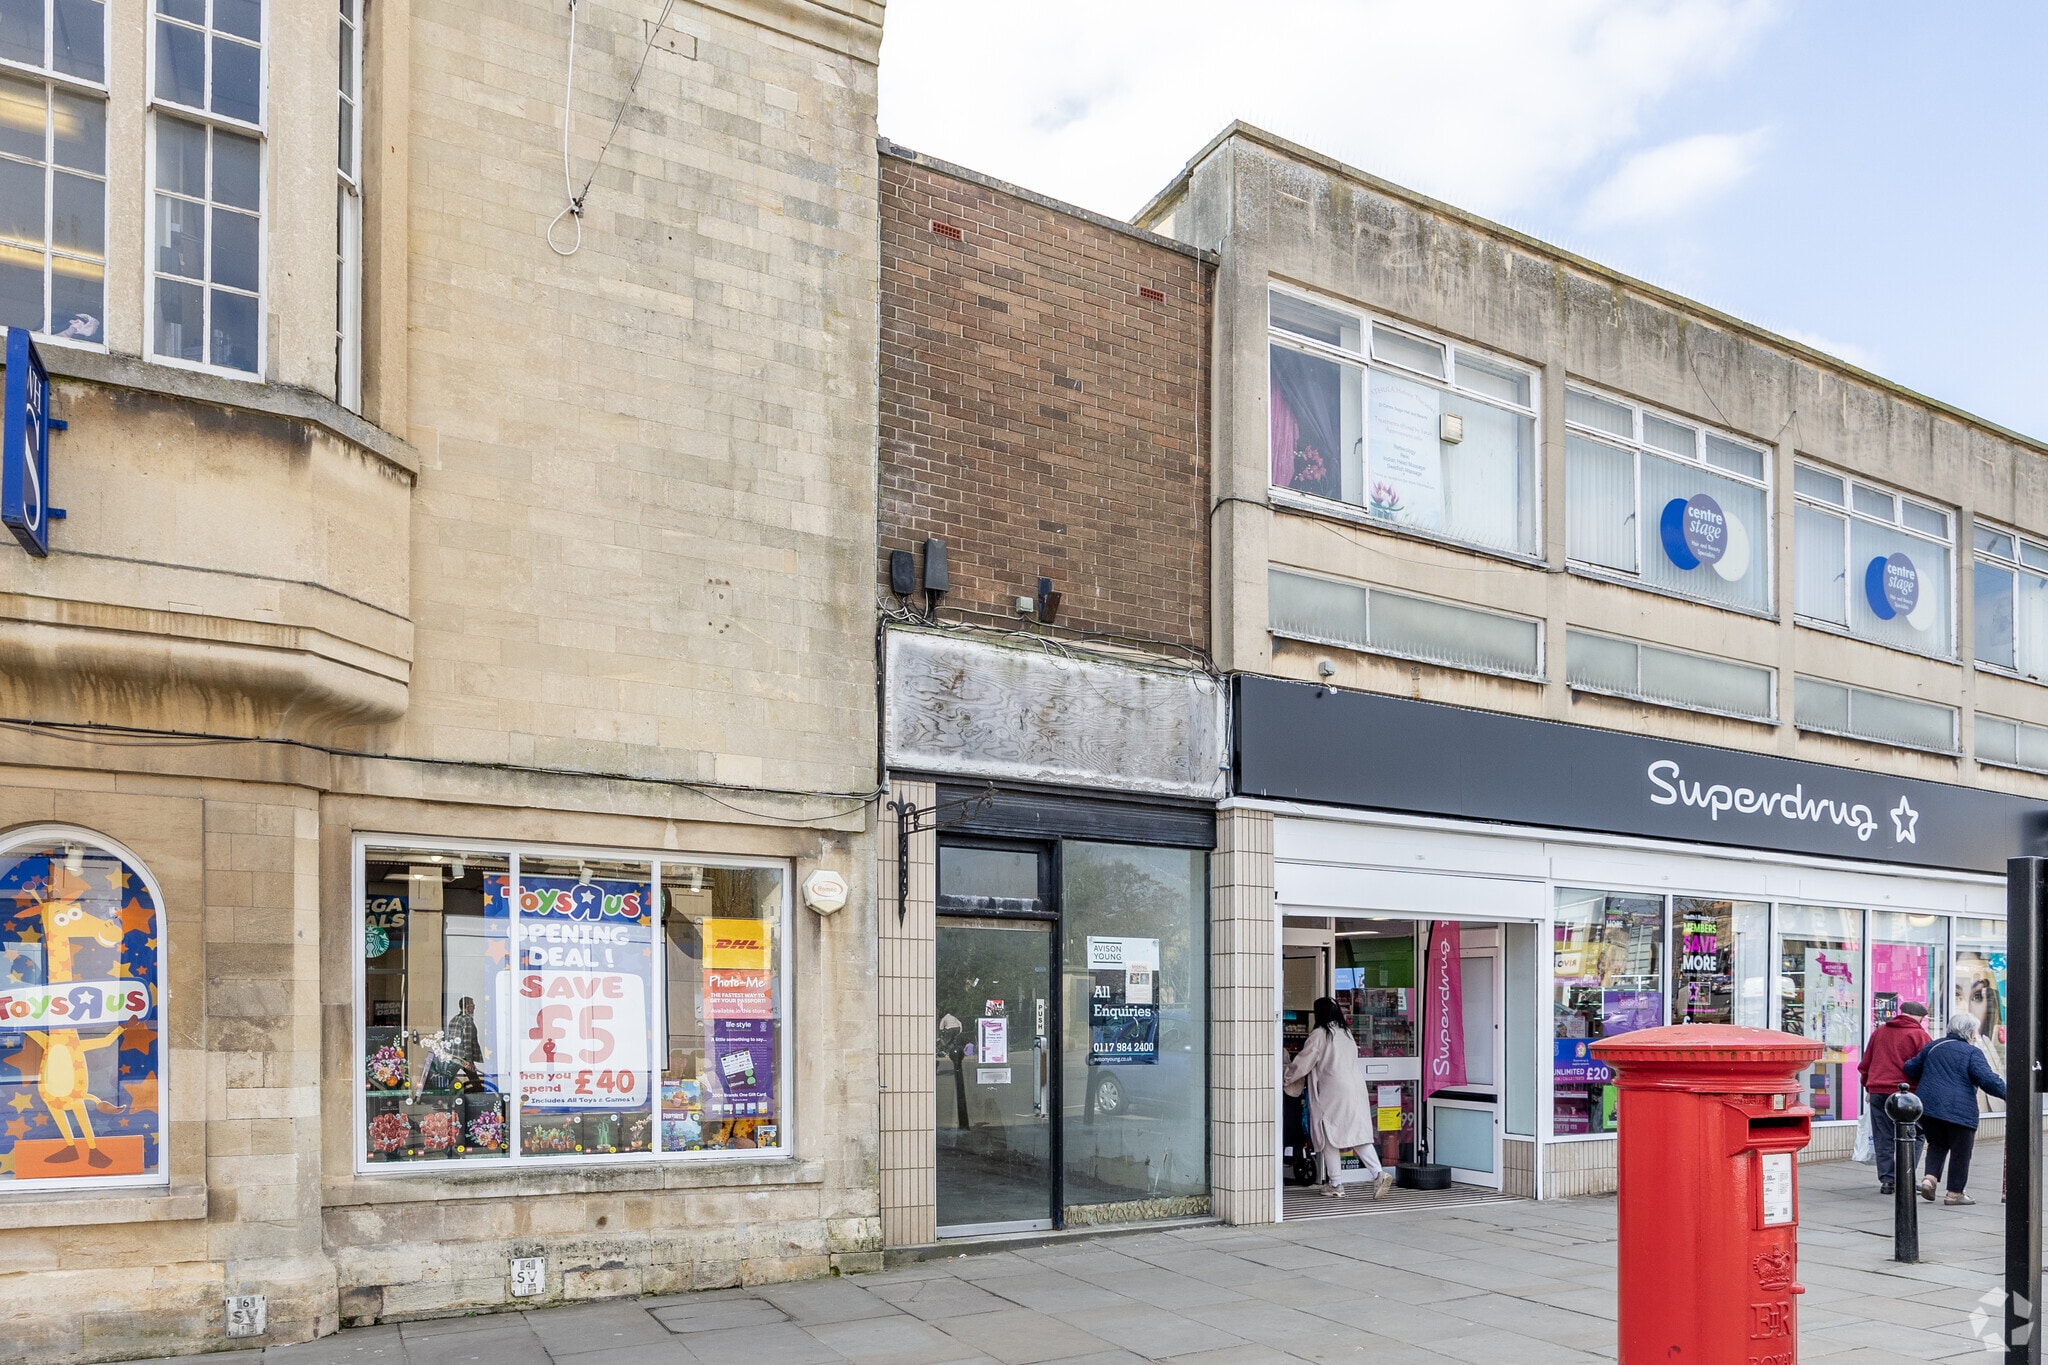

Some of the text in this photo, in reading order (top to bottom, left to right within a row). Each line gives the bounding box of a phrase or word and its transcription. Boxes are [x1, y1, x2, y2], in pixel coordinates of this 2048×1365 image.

[1688, 506, 1723, 525] centre
[1689, 520, 1722, 542] stage
[1887, 564, 1916, 580] centre
[1888, 576, 1914, 595] stage
[1648, 760, 1878, 841] Superdrug
[1683, 923, 1717, 934] MEMBERS
[714, 938, 760, 950] DHL
[1093, 945, 1122, 953] AVISON
[1683, 934, 1717, 954] SAVE
[1683, 955, 1717, 971] MORE
[520, 975, 624, 999] SAVE
[709, 975, 766, 988] Photo-Me
[1093, 985, 1111, 998] All
[1093, 1004, 1152, 1020] Enquiries
[1432, 938, 1451, 1076] Superdrug
[528, 1004, 616, 1065] £5
[1093, 1043, 1154, 1052] 0117 984 2400
[1586, 1066, 1608, 1080] £20
[522, 1084, 562, 1095] spend
[547, 1072, 571, 1082] you
[574, 1069, 635, 1095] £40
[579, 1096, 597, 1104] Toys
[242, 1299, 250, 1308] 6
